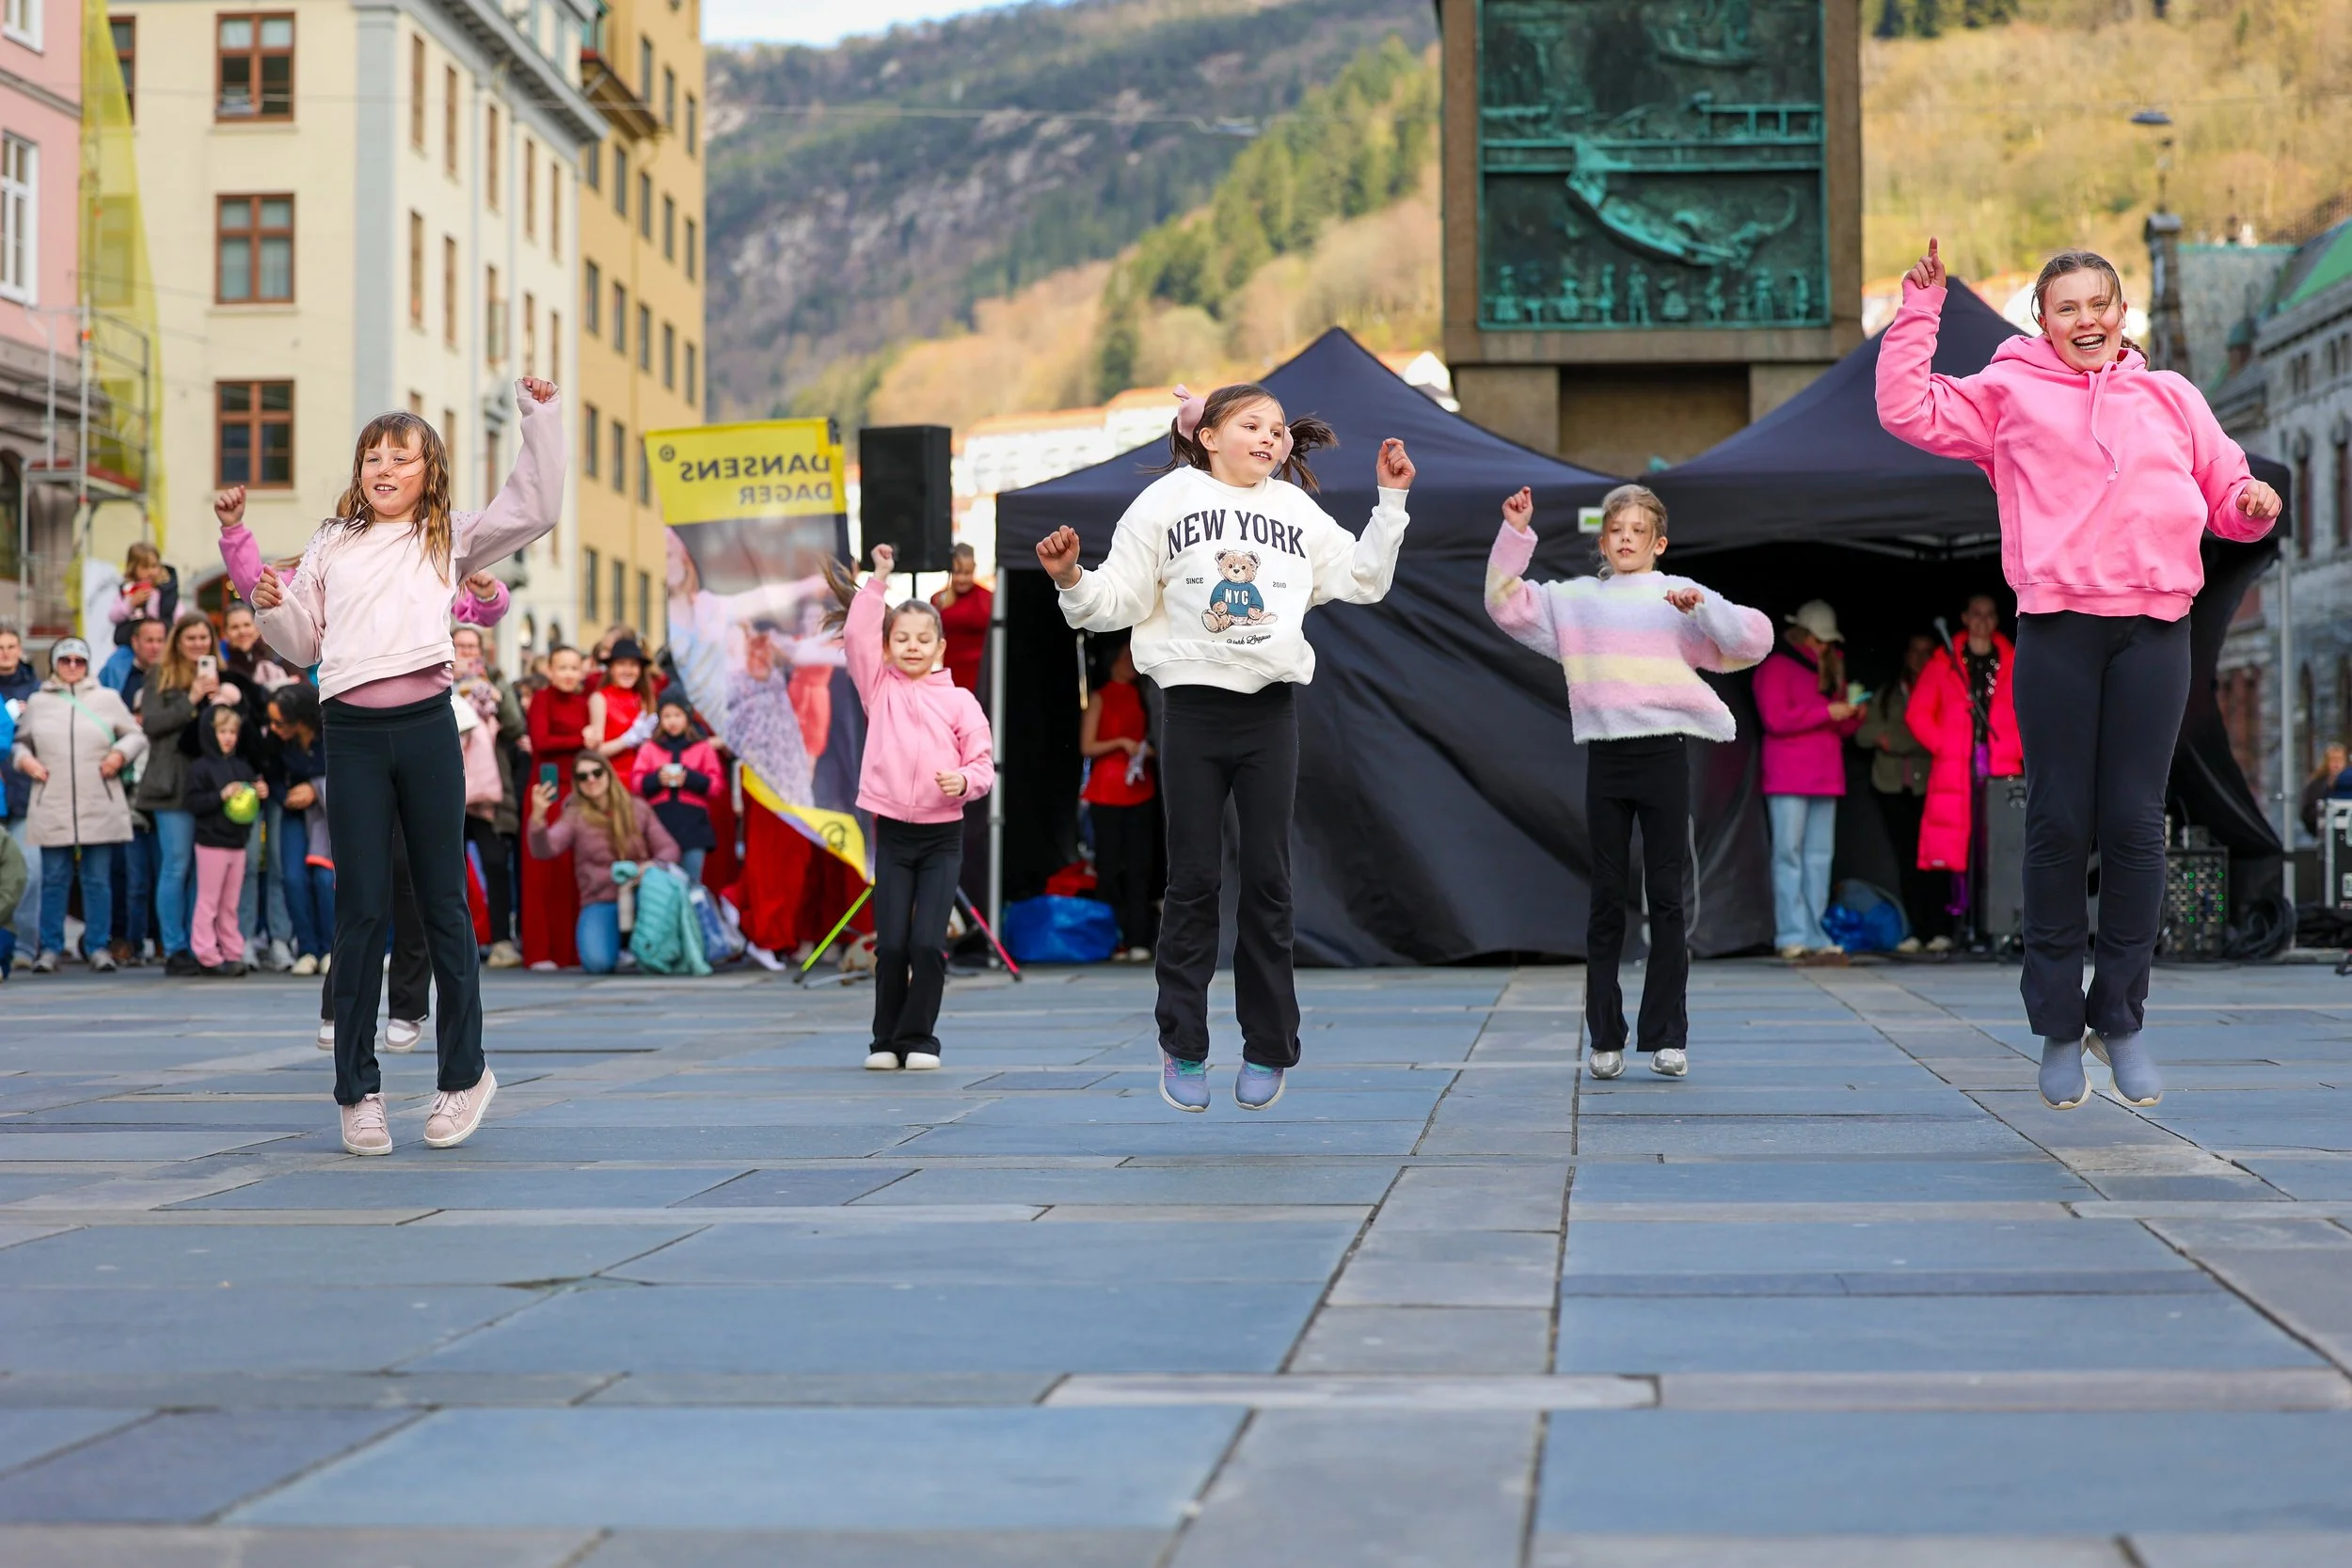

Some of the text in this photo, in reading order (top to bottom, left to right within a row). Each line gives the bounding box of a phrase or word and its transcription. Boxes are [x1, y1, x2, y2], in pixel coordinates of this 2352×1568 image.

[1167, 509, 1306, 561] NEW YORK
[1185, 577, 1204, 585] SINCE
[1224, 588, 1249, 606] NYC
